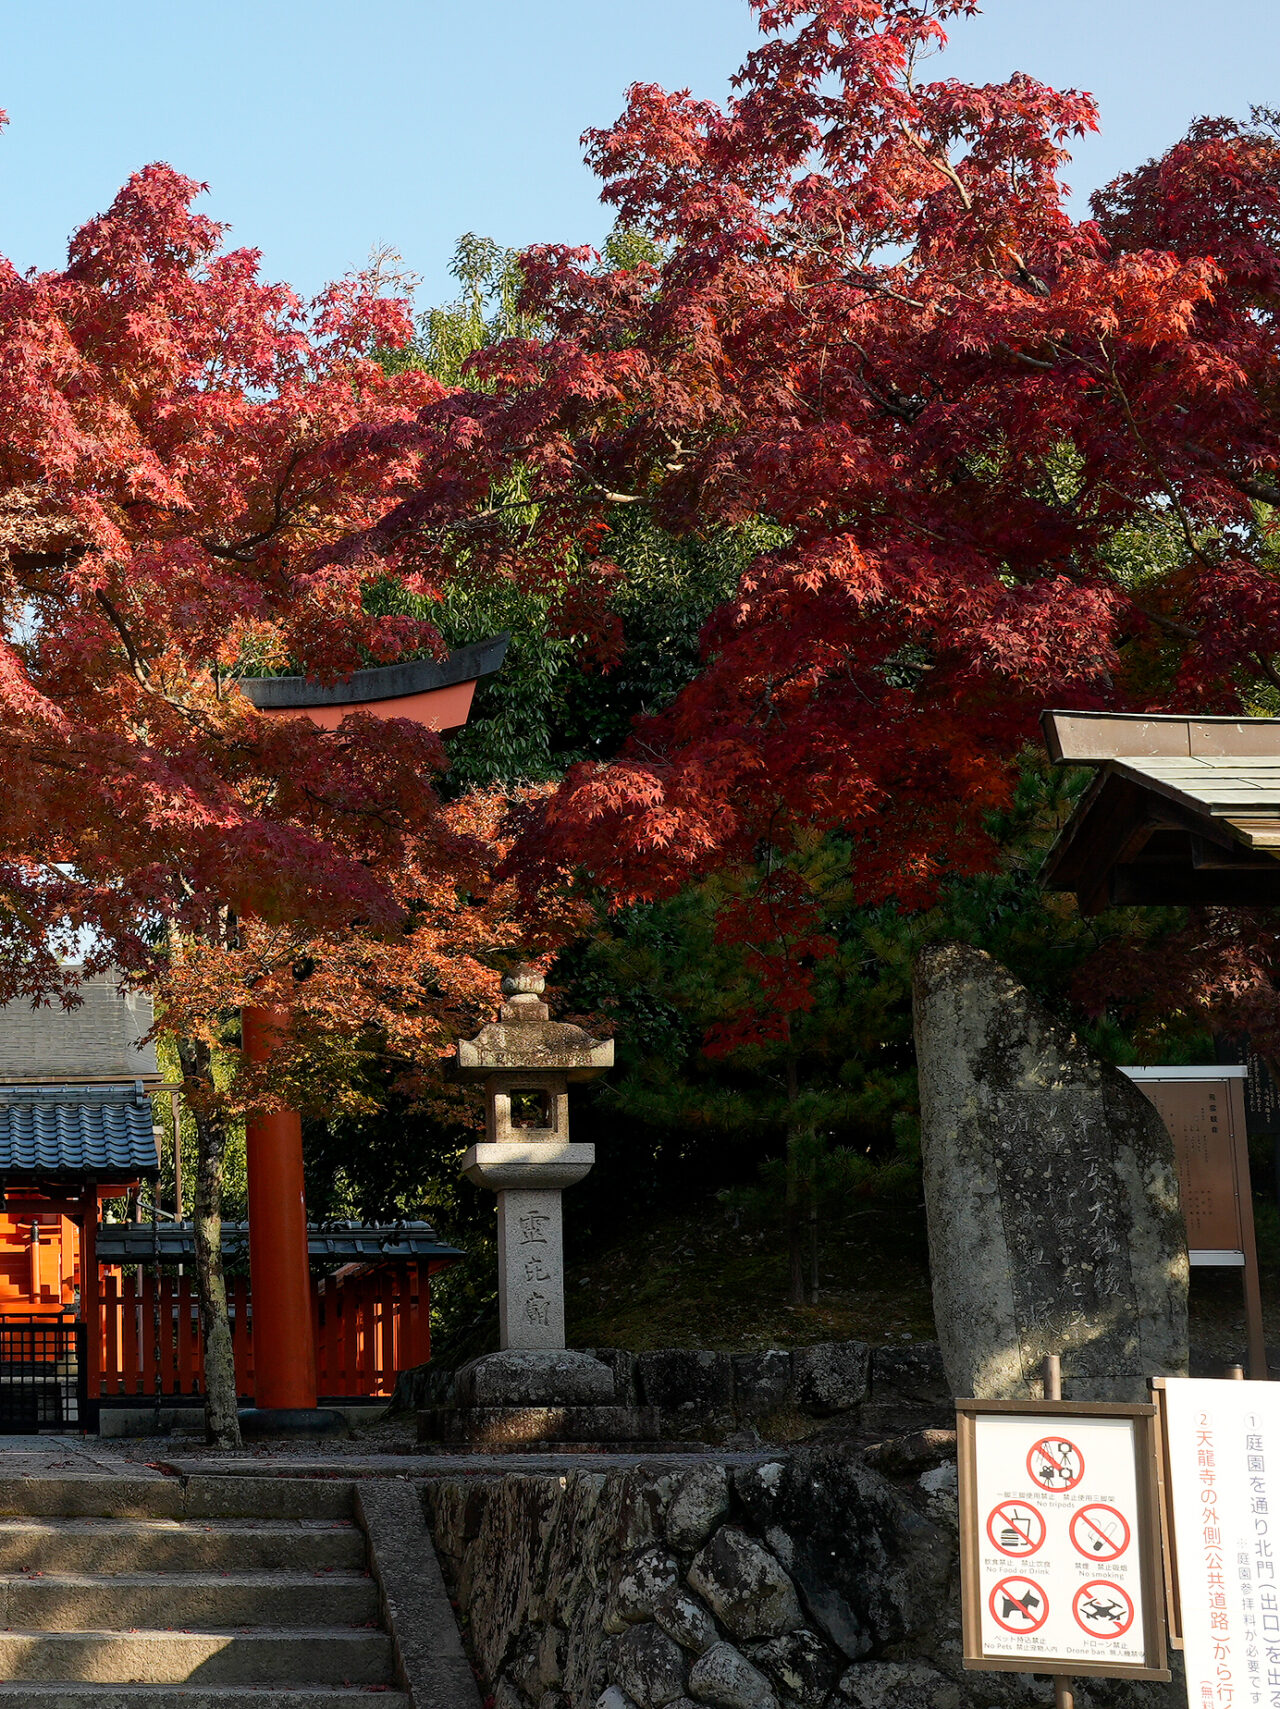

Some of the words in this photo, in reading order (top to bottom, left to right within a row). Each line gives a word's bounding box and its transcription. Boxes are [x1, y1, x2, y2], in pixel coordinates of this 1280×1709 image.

[1049, 1501, 1075, 1509] tripods
[999, 1566, 1018, 1574] Food
[1091, 1571, 1125, 1580] smoking
[1083, 1640, 1129, 1649] ドローン禁止
[1066, 1646, 1090, 1655] Drone
[1091, 1647, 1106, 1655] ban
